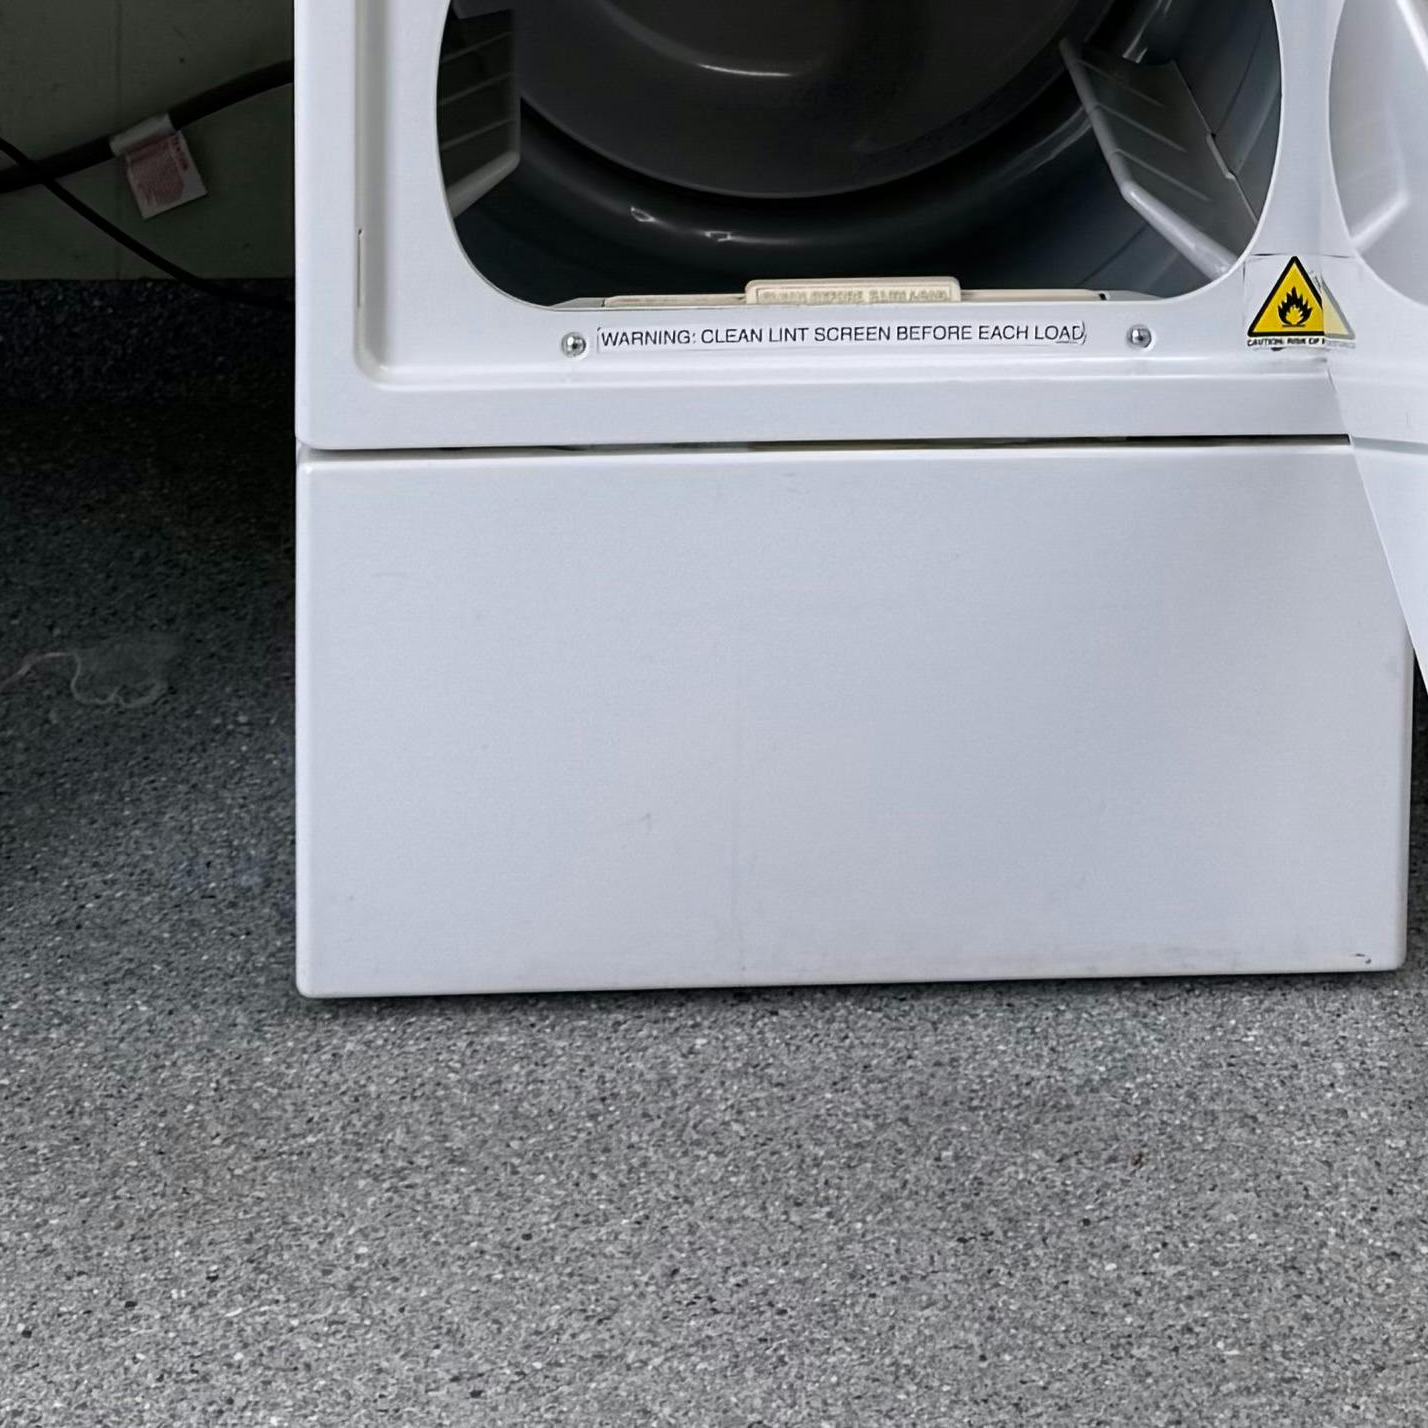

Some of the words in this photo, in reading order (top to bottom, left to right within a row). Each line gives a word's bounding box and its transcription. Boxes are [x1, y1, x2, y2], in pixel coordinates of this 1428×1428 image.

[601, 330, 697, 346] WARNING:
[701, 328, 763, 344] CLEAN
[769, 327, 809, 343] LINT
[814, 326, 891, 342] SCREEN
[897, 325, 972, 341] BEFORE
[978, 325, 1029, 340] EACH
[1034, 325, 1084, 340] LOAD
